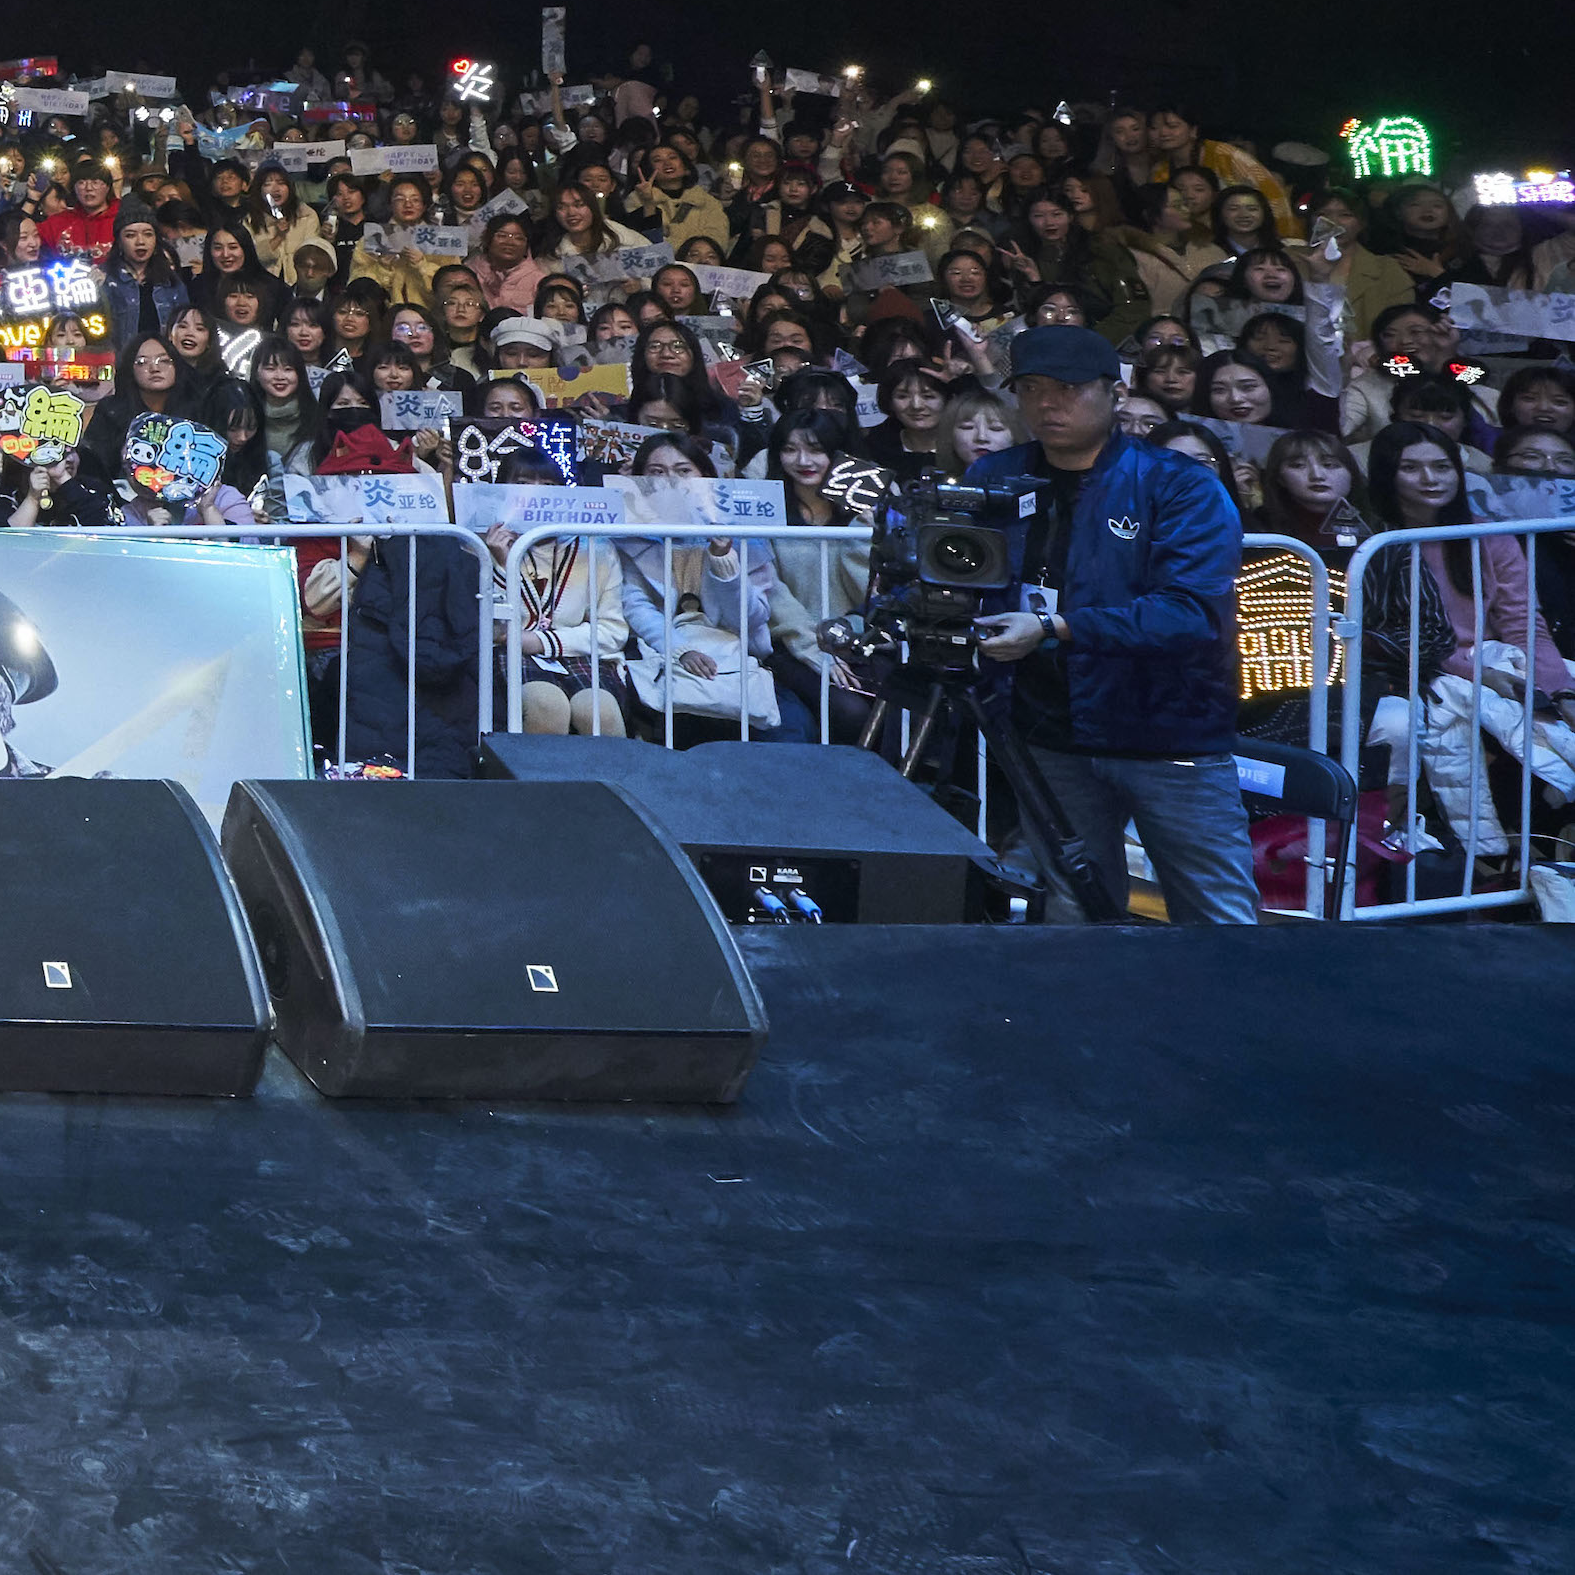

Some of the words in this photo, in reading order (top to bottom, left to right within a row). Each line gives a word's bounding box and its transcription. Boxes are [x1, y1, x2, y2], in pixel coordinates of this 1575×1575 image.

[454, 63, 493, 100] 炎
[396, 394, 455, 418] 炎亚
[364, 479, 436, 509] 炎亚纶
[515, 497, 576, 510] HAPPY
[524, 510, 618, 523] BIRTHDAY
[777, 867, 799, 875] KARA
